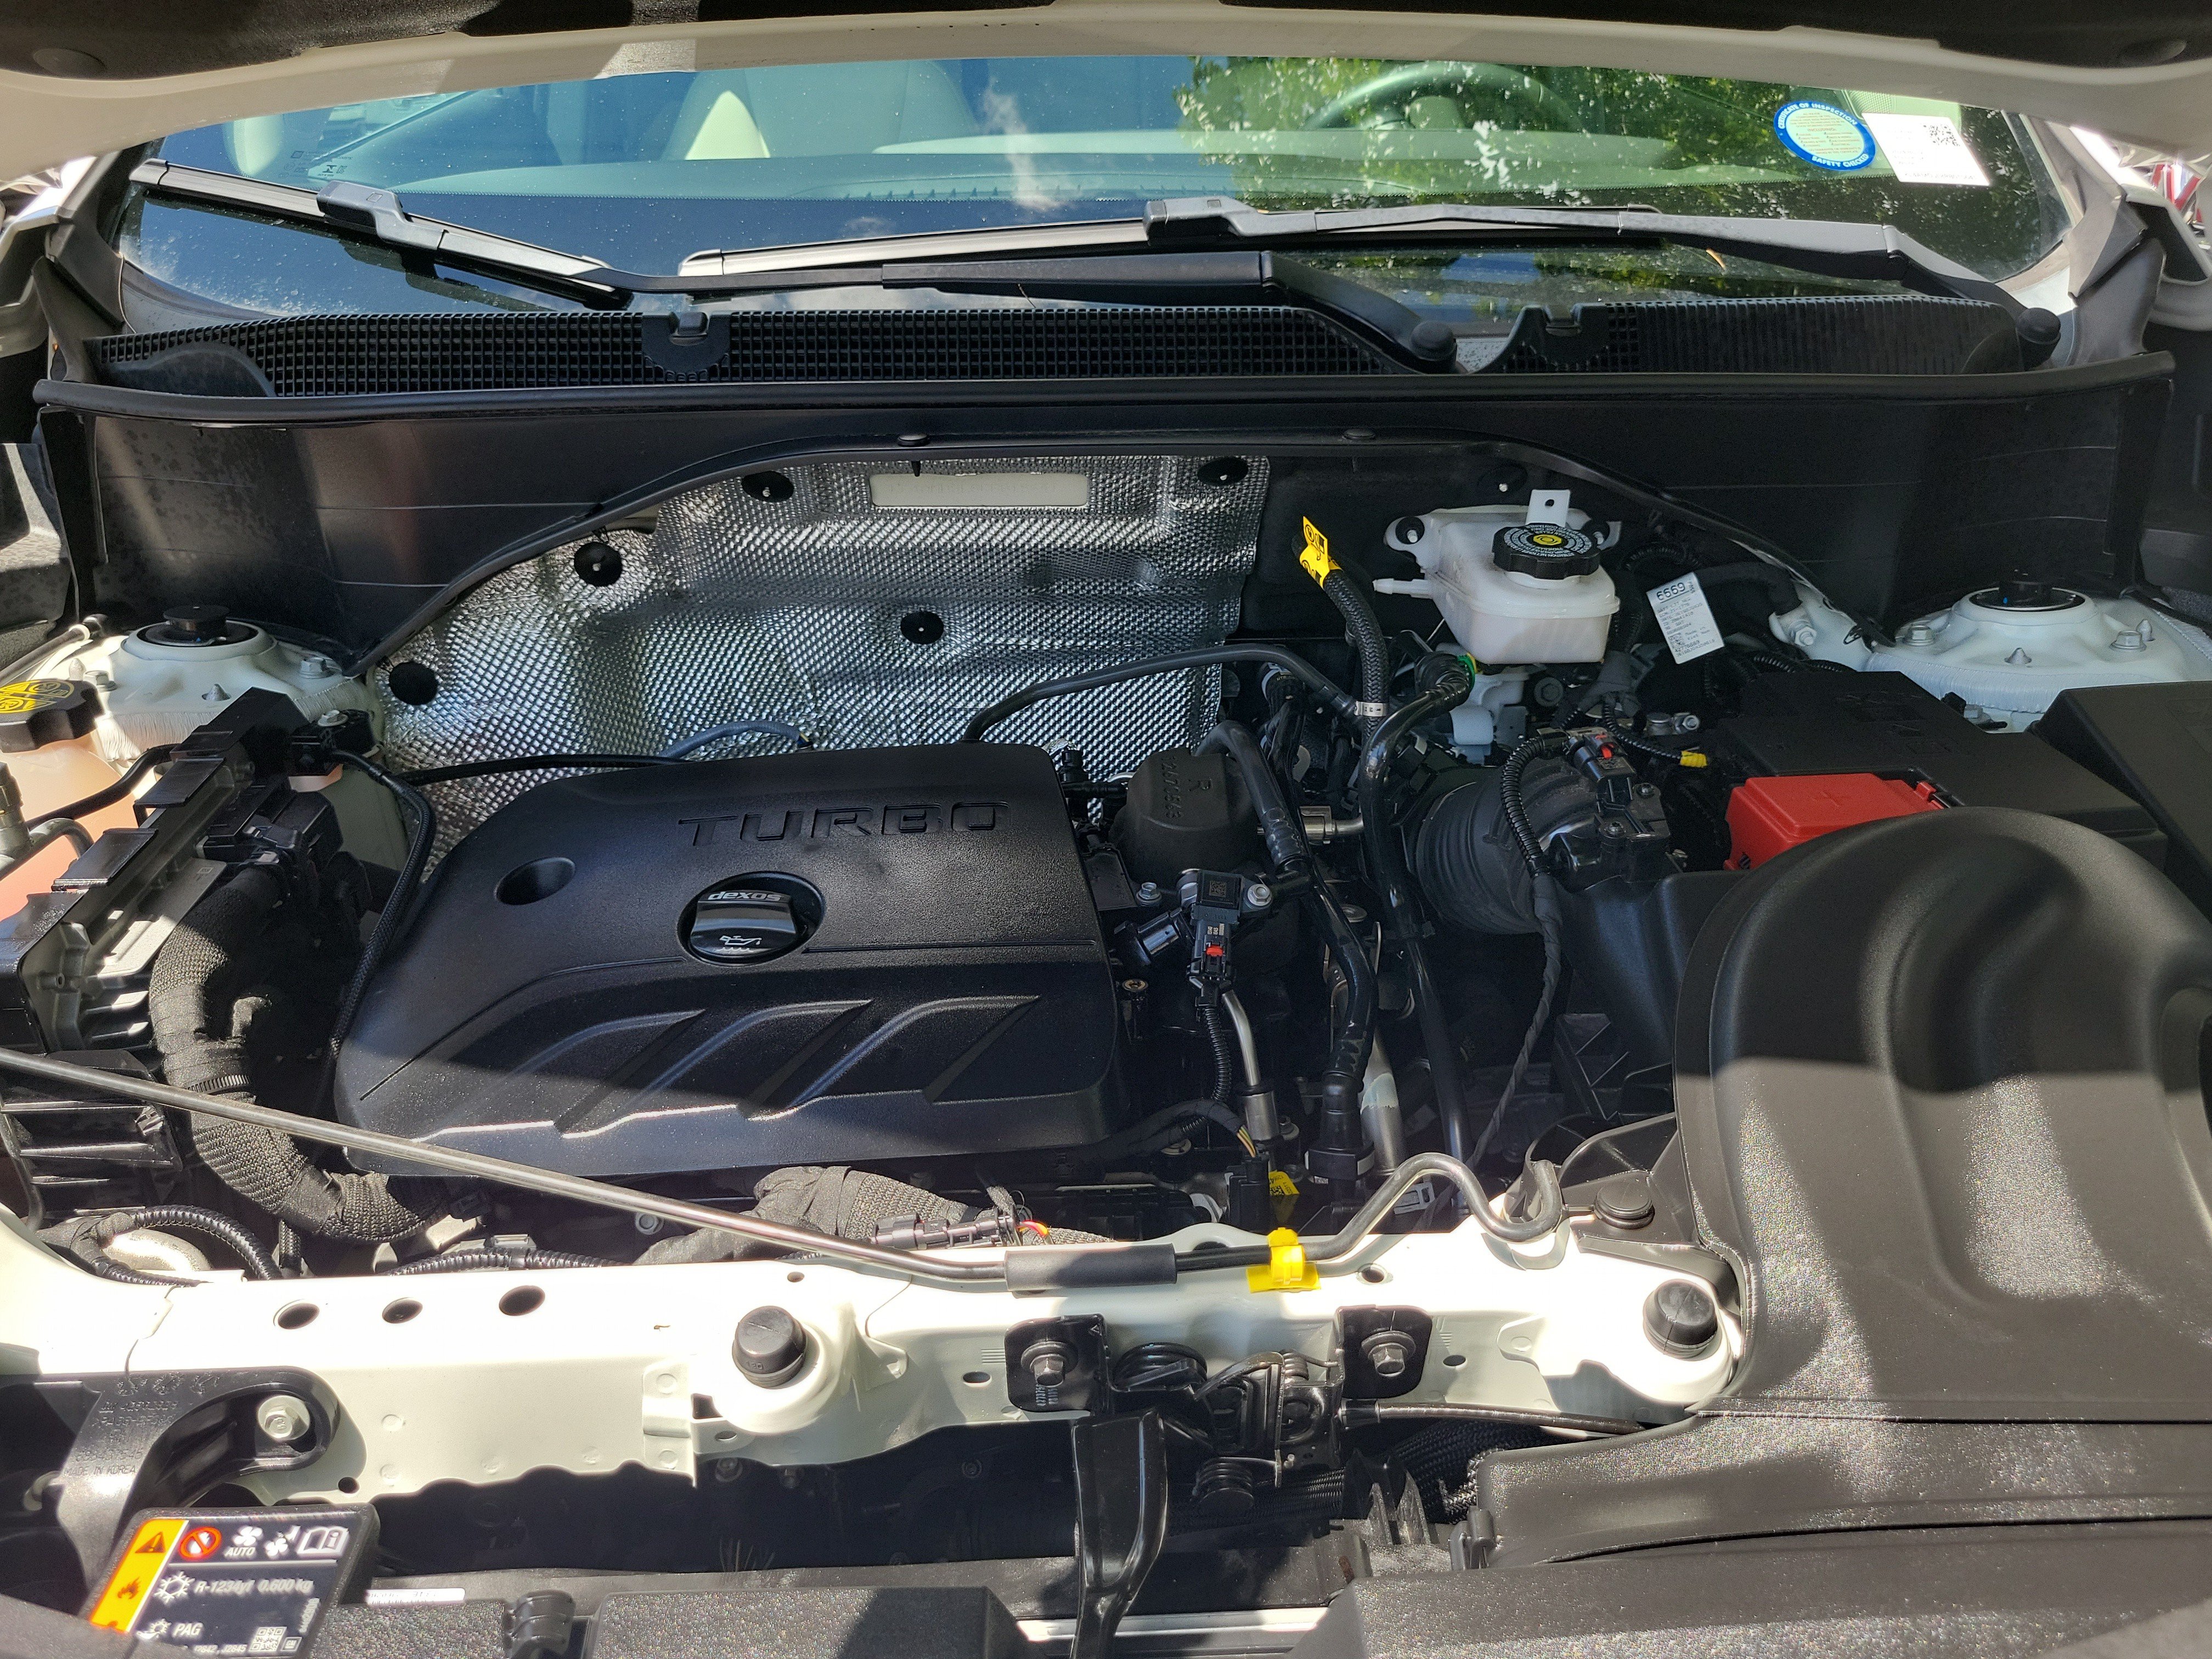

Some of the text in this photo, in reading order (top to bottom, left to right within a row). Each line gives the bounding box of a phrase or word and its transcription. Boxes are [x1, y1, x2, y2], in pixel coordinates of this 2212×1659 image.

[1778, 104, 1799, 129] CERTIFICATE
[1812, 103, 1858, 125] INSPECTION
[1812, 154, 1869, 167] SAFETY CHECKED
[1657, 583, 1686, 600] 6669
[678, 800, 1009, 846] TURBO
[708, 891, 781, 901] dexos
[224, 1547, 255, 1556] AUTO
[194, 1579, 313, 1594] R-1234yf 0.600 kg
[172, 1623, 203, 1637] PAG
